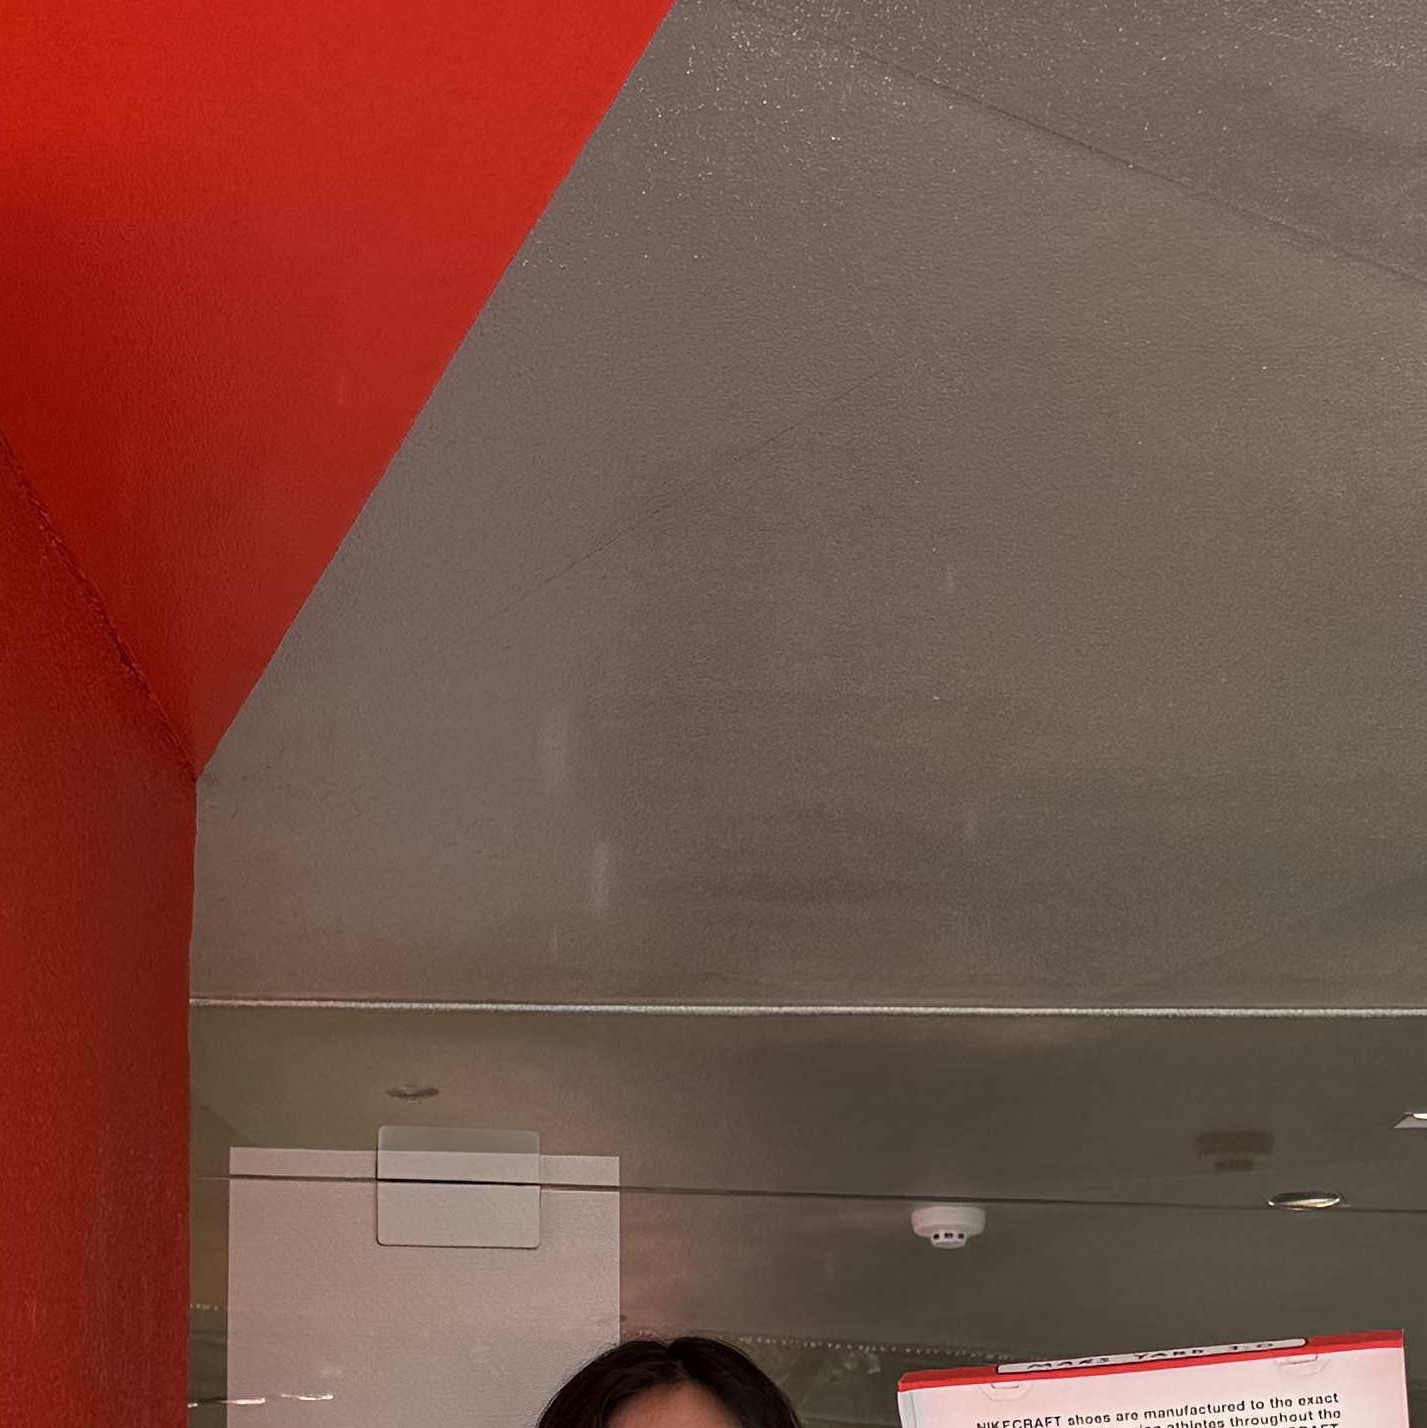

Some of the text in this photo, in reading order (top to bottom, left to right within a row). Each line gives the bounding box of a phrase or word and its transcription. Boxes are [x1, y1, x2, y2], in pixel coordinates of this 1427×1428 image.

[1068, 1414, 1111, 1426] shoes
[1116, 1412, 1138, 1422] are
[1144, 1400, 1245, 1419] manufactured
[1250, 1400, 1264, 1410] to
[1269, 1397, 1293, 1409] the
[1298, 1393, 1339, 1406] exact
[1229, 1410, 1314, 1427] throughout
[1318, 1408, 1341, 1420] the
